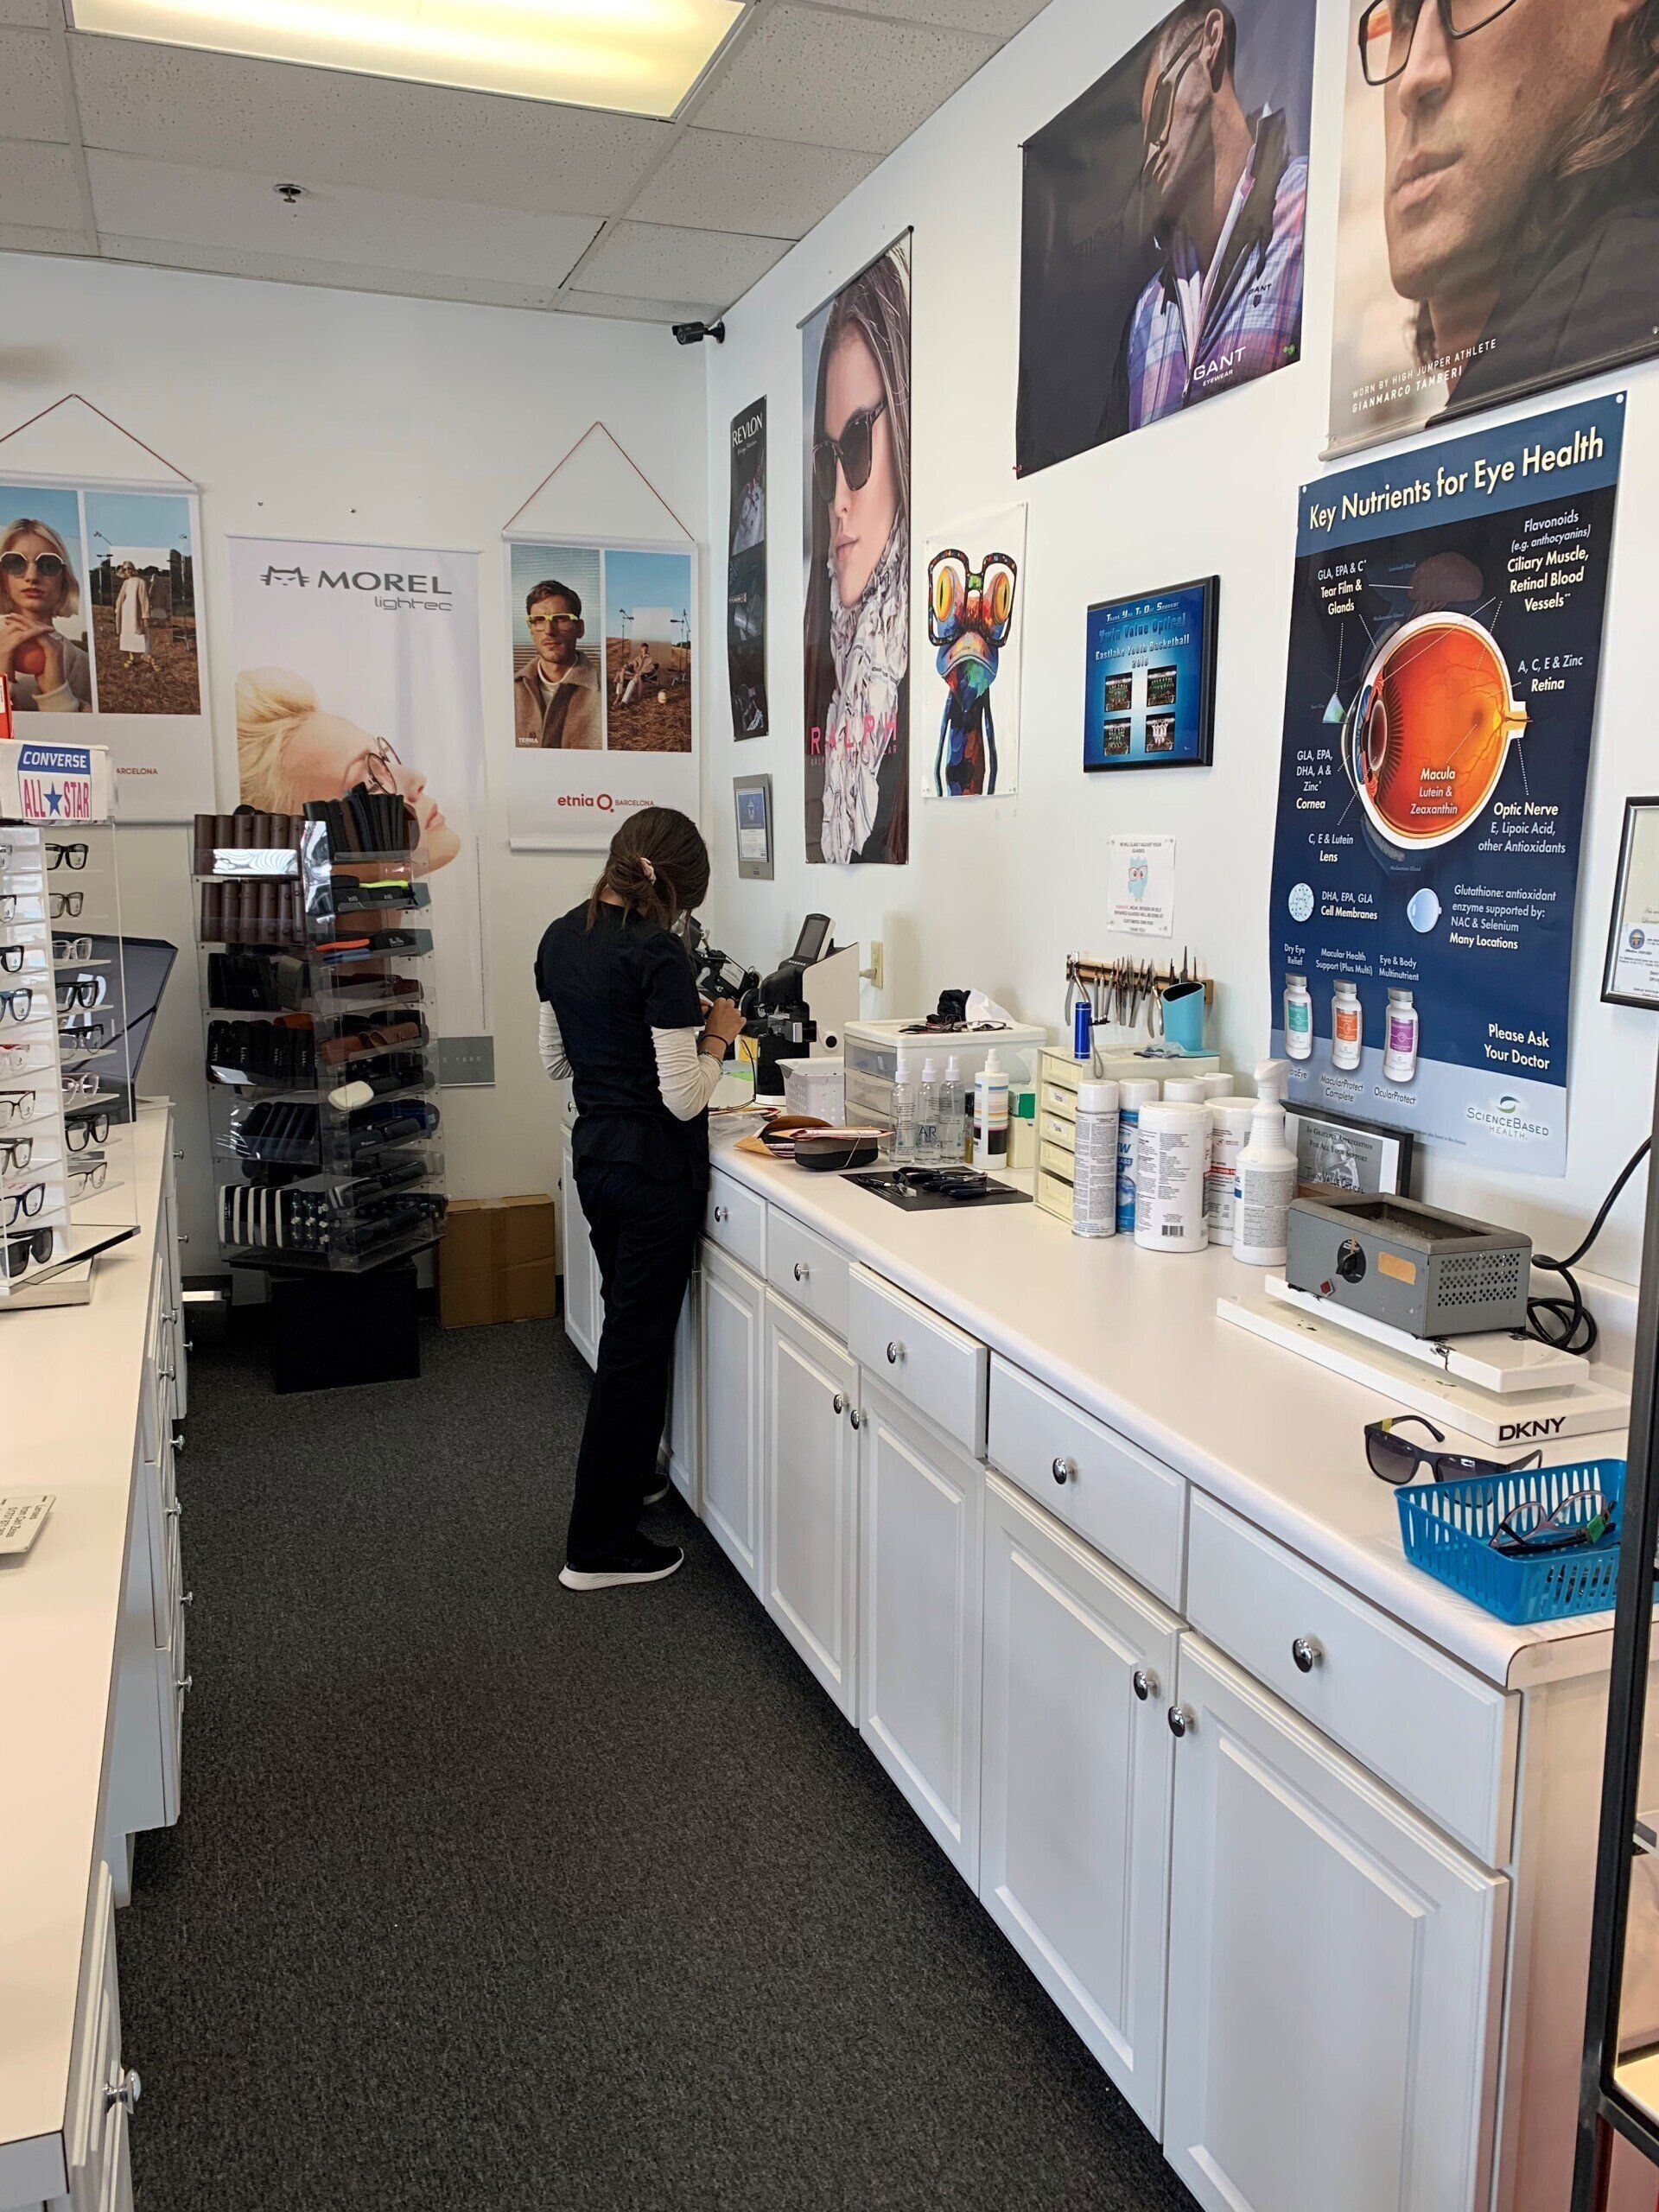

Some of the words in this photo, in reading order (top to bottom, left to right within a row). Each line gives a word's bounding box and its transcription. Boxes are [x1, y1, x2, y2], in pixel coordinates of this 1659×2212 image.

[1193, 346, 1246, 380] GANT
[1352, 384, 1376, 399] WORN
[1378, 378, 1389, 390] BY
[1392, 370, 1414, 385] HIGH
[1416, 355, 1451, 377] JUMPER
[1454, 338, 1497, 362] ATHLETE
[1203, 369, 1233, 386] EYEWEAR
[1352, 385, 1411, 413] GIANMARCO
[1415, 365, 1463, 391] TAMBERI
[732, 412, 763, 448] REVLON
[1309, 504, 1337, 532] Key
[1341, 479, 1432, 520] Nutrients
[1437, 467, 1468, 498] for
[1474, 459, 1515, 495] Eye
[1522, 426, 1604, 477] Health
[1524, 508, 1579, 533] Flavonoids
[1511, 539, 1529, 553] (e.g.
[1531, 524, 1591, 547] anthocyanins)
[1507, 556, 1543, 573] Ciliary
[1545, 544, 1589, 566] Muscle,
[1318, 568, 1334, 581] GLA,
[1335, 563, 1349, 577] EPA
[1350, 563, 1357, 574] &
[1510, 572, 1548, 594] Retinal
[1550, 566, 1585, 587] Blood
[317, 570, 452, 594] MOREL
[1320, 585, 1337, 598] Tear
[1338, 580, 1354, 595] Film
[1355, 578, 1363, 592] &
[375, 595, 453, 612] lightec
[1328, 598, 1355, 615] Glands
[1124, 623, 1149, 639] Value
[1152, 612, 1186, 635] Optical
[1095, 648, 1125, 662] Eastlake
[1149, 633, 1190, 652] Basketball
[1517, 659, 1529, 674] A,
[1531, 658, 1541, 672] C,
[1544, 658, 1551, 670] E
[1552, 656, 1560, 669] &
[1562, 654, 1583, 668] Zinc
[1531, 677, 1566, 693] Retina
[810, 711, 897, 755] RALPH
[22, 751, 86, 769] CONVERSE
[1297, 750, 1314, 761] GLA,
[1317, 749, 1333, 761] EPA,
[1296, 765, 1315, 777] DHA,
[1317, 766, 1325, 776] A
[1325, 765, 1332, 776] &
[1420, 766, 1456, 780] Macula
[23, 779, 46, 818] ALL
[63, 780, 90, 818] STAR
[557, 793, 594, 807] etnia
[1419, 785, 1444, 798] Lutein
[1445, 785, 1452, 798] &
[1296, 798, 1326, 810] Cornea
[1410, 803, 1458, 815] Zeaxanthin
[1493, 802, 1522, 819] Optic
[1524, 802, 1559, 816] Nerve
[1491, 821, 1499, 835] E,
[1502, 821, 1529, 837] Lipoic
[1531, 821, 1556, 836] Acid,
[1308, 833, 1316, 845] C,
[1318, 834, 1324, 843] E
[1324, 833, 1331, 844] &
[1332, 833, 1354, 845] Lutein
[1478, 838, 1503, 852] other
[1504, 839, 1566, 854] Antioxidants
[1319, 850, 1338, 862] Lens
[1322, 891, 1339, 903] DHA,
[1341, 892, 1356, 904] EPA,
[1357, 893, 1373, 904] GLA
[1454, 883, 1504, 899] Glutathione:
[1505, 887, 1556, 901] antioxidant
[1320, 906, 1334, 917] Cell
[1335, 906, 1378, 920] Membranes
[1452, 903, 1484, 915] enzyme
[1485, 904, 1529, 918] supported
[1530, 905, 1546, 920] by:
[1451, 916, 1471, 928] NAC
[1471, 918, 1479, 929] &
[1480, 918, 1519, 932] Selenium
[1449, 931, 1474, 948] Many
[1476, 934, 1518, 950] Locations
[1284, 944, 1295, 955] Dry
[1295, 944, 1306, 956] Eye
[1320, 948, 1345, 959] Macular
[1345, 950, 1366, 962] Health
[1287, 957, 1303, 966] Relief
[1316, 959, 1339, 972] Support
[1339, 962, 1355, 973] (Plus
[1355, 963, 1373, 976] Multi)
[1379, 955, 1391, 965] Eye
[1393, 956, 1399, 966] &
[1400, 957, 1417, 969] Body
[1379, 968, 1420, 982] Multinutrient
[1488, 1023, 1525, 1044] Please
[1528, 1031, 1550, 1048] Ask
[1484, 1044, 1510, 1062] Your
[1512, 1049, 1550, 1070] Doctor
[1321, 1074, 1363, 1092] MacularProtect
[1325, 1087, 1355, 1103] Complete
[1374, 1086, 1417, 1105] OcularProtect
[918, 1126, 938, 1138] AR
[1314, 1128, 1338, 1141] GRATEFUL
[1339, 1135, 1373, 1150] APPRECIATION
[1321, 1143, 1330, 1152] ALL
[1331, 1146, 1345, 1155] YOUR
[1346, 1150, 1368, 1162] SUPPORT
[1323, 1171, 1340, 1187] VALUE
[1498, 1416, 1567, 1441] DKNY
